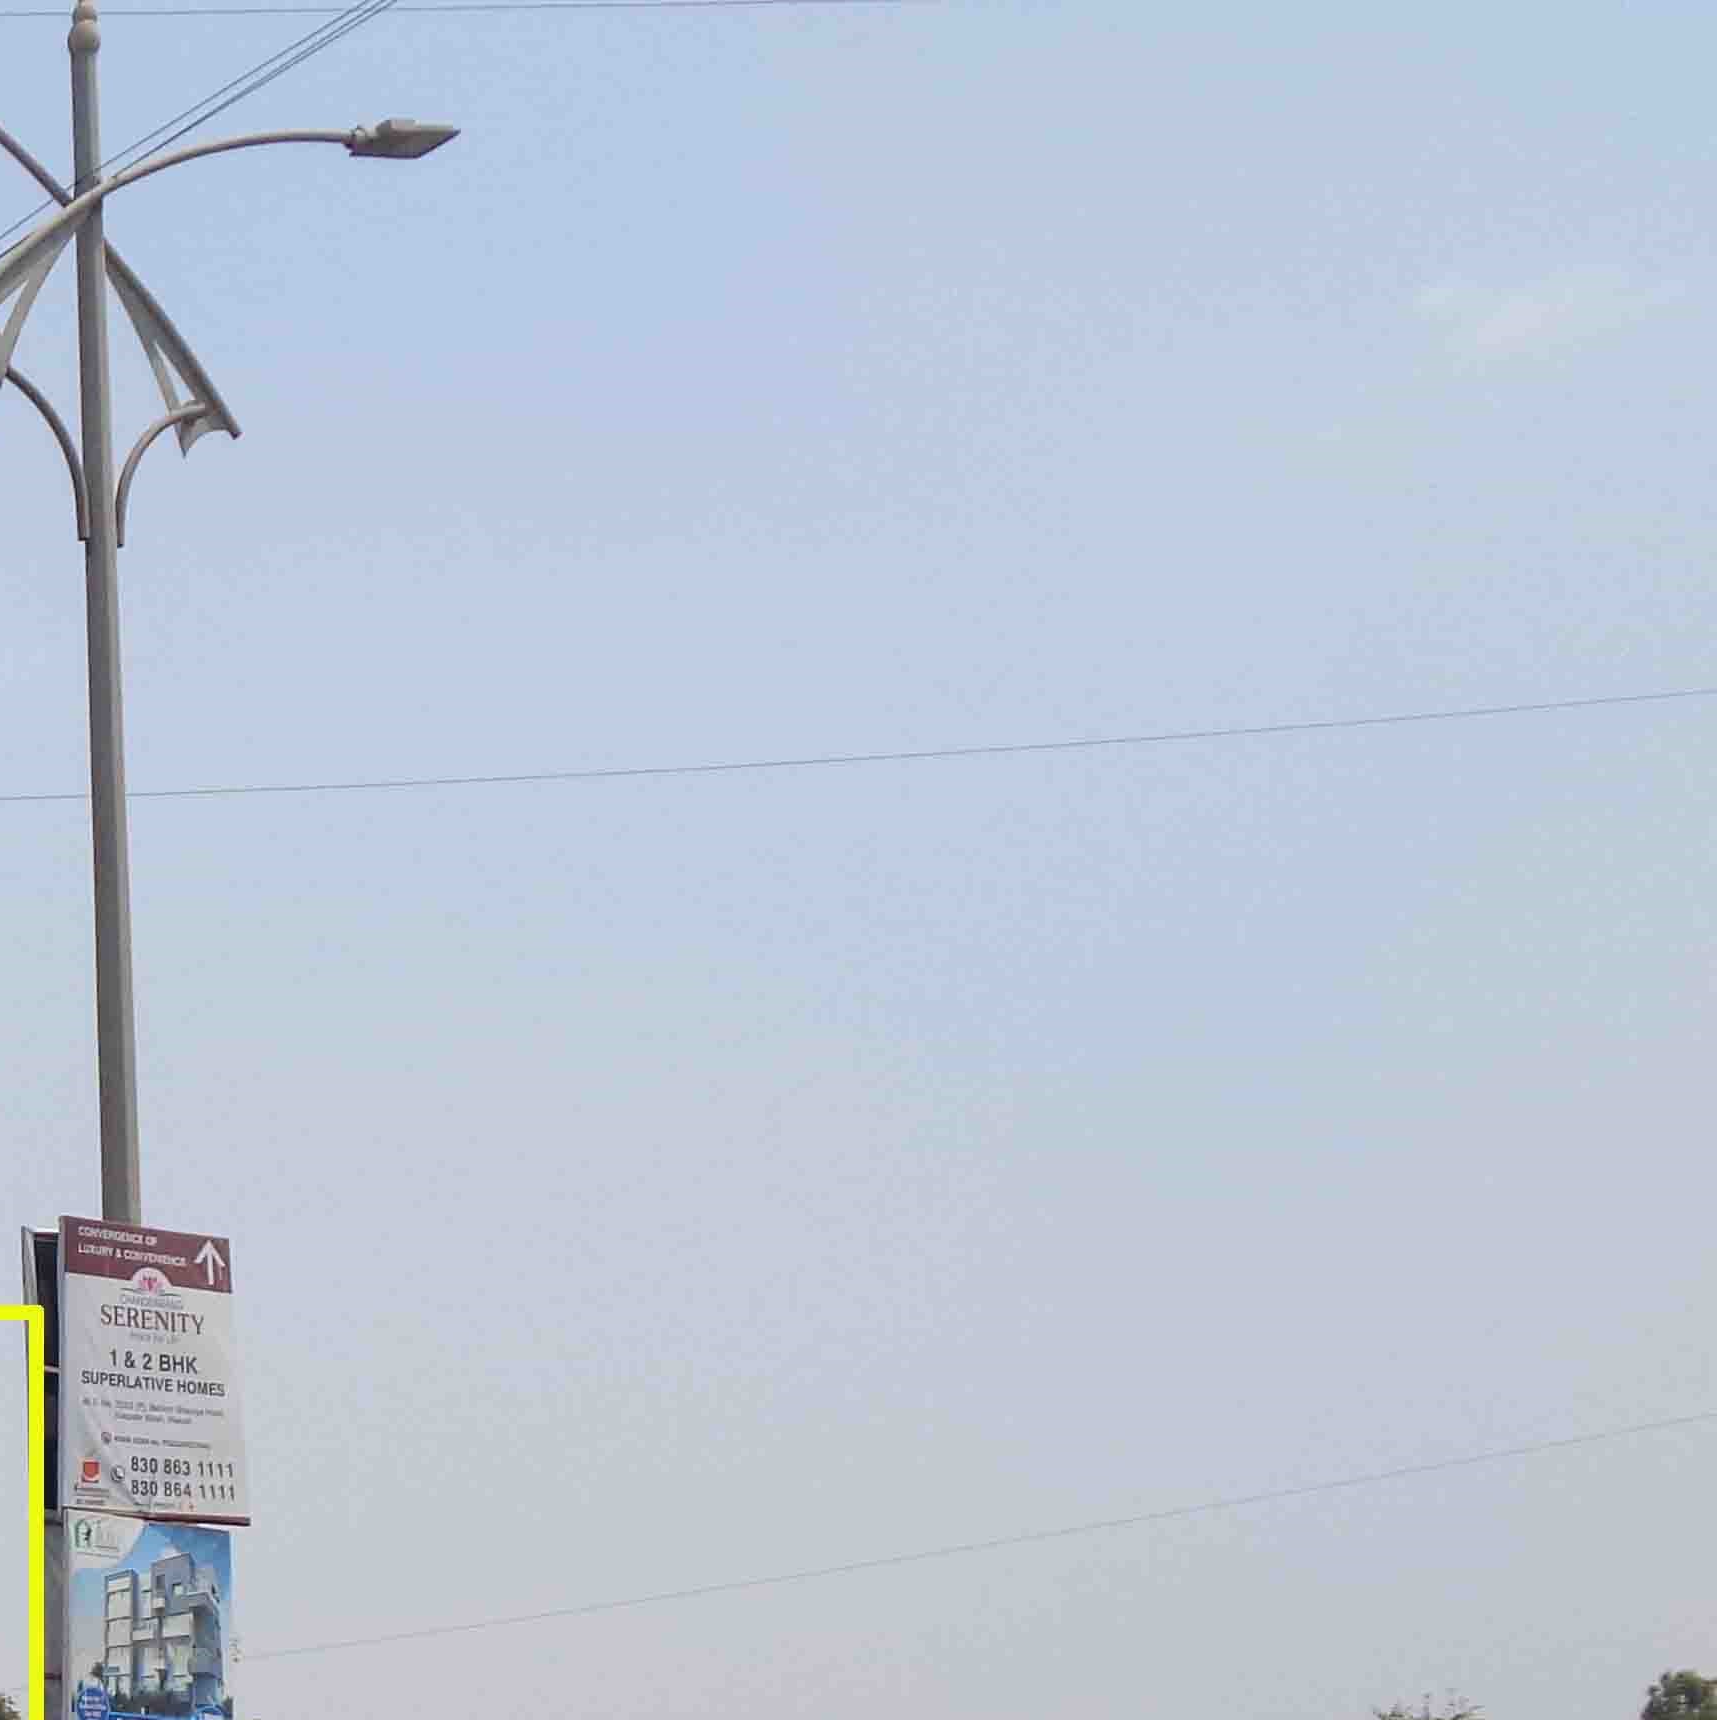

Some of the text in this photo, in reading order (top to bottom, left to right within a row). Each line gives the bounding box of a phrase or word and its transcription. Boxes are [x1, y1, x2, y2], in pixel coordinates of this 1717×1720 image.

[101, 1303, 205, 1335] SERENITY
[109, 1349, 198, 1375] 1 & 2 BHK
[81, 1371, 226, 1397] SUPERLATIVE HOMES
[131, 1456, 158, 1473] 830
[197, 1461, 234, 1478] 1111
[131, 1480, 158, 1497] 830
[198, 1484, 235, 1500] 1111
